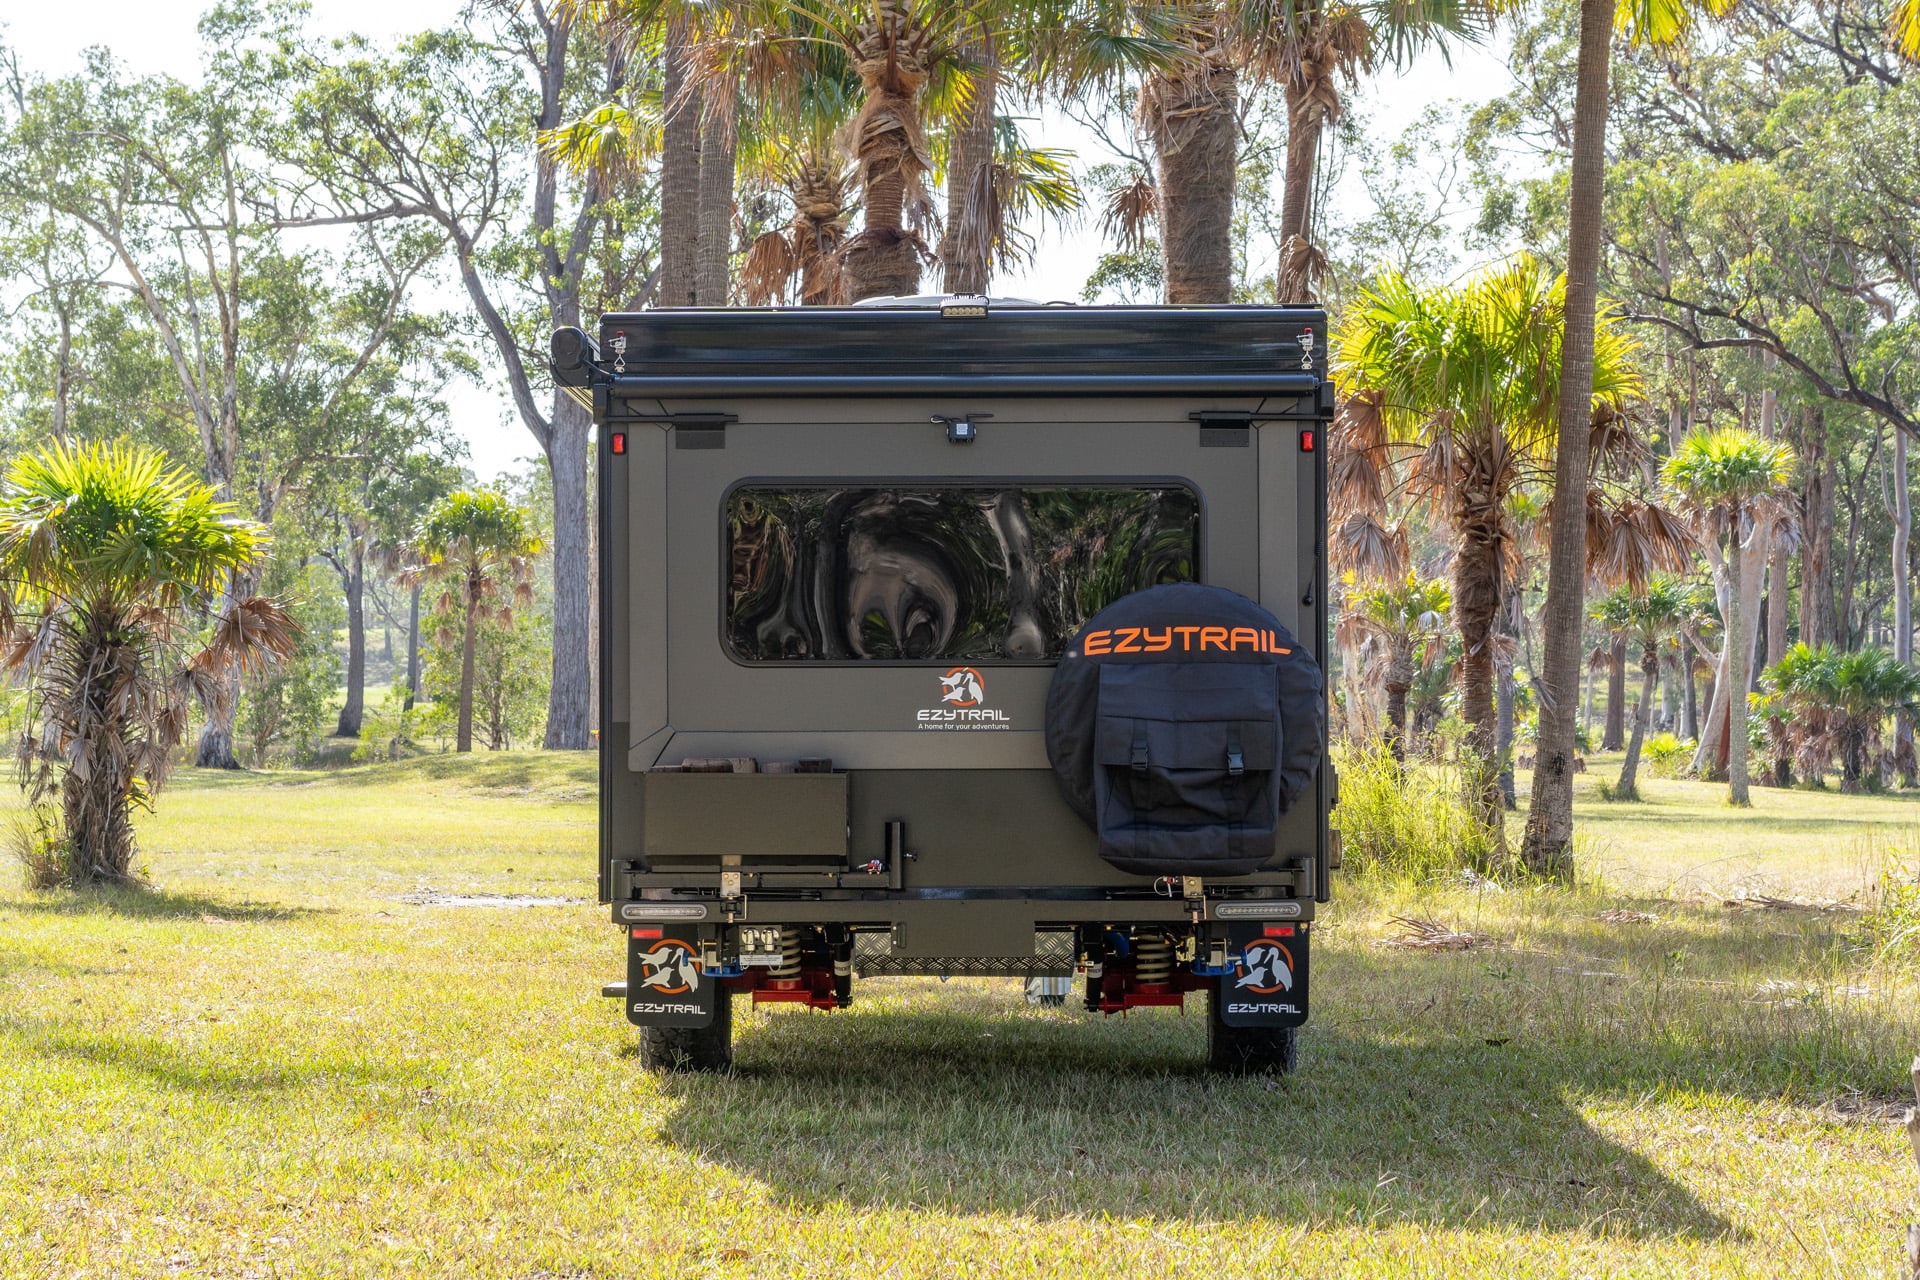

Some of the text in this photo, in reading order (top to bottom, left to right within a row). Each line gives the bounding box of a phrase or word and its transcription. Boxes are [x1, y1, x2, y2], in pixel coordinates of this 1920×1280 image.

[1084, 626, 1292, 656] EZYTRAIL
[916, 709, 1011, 721] EZYTRAIL
[633, 1003, 707, 1015] EZYTRAIL
[1227, 1003, 1302, 1014] EZYTRAIL
